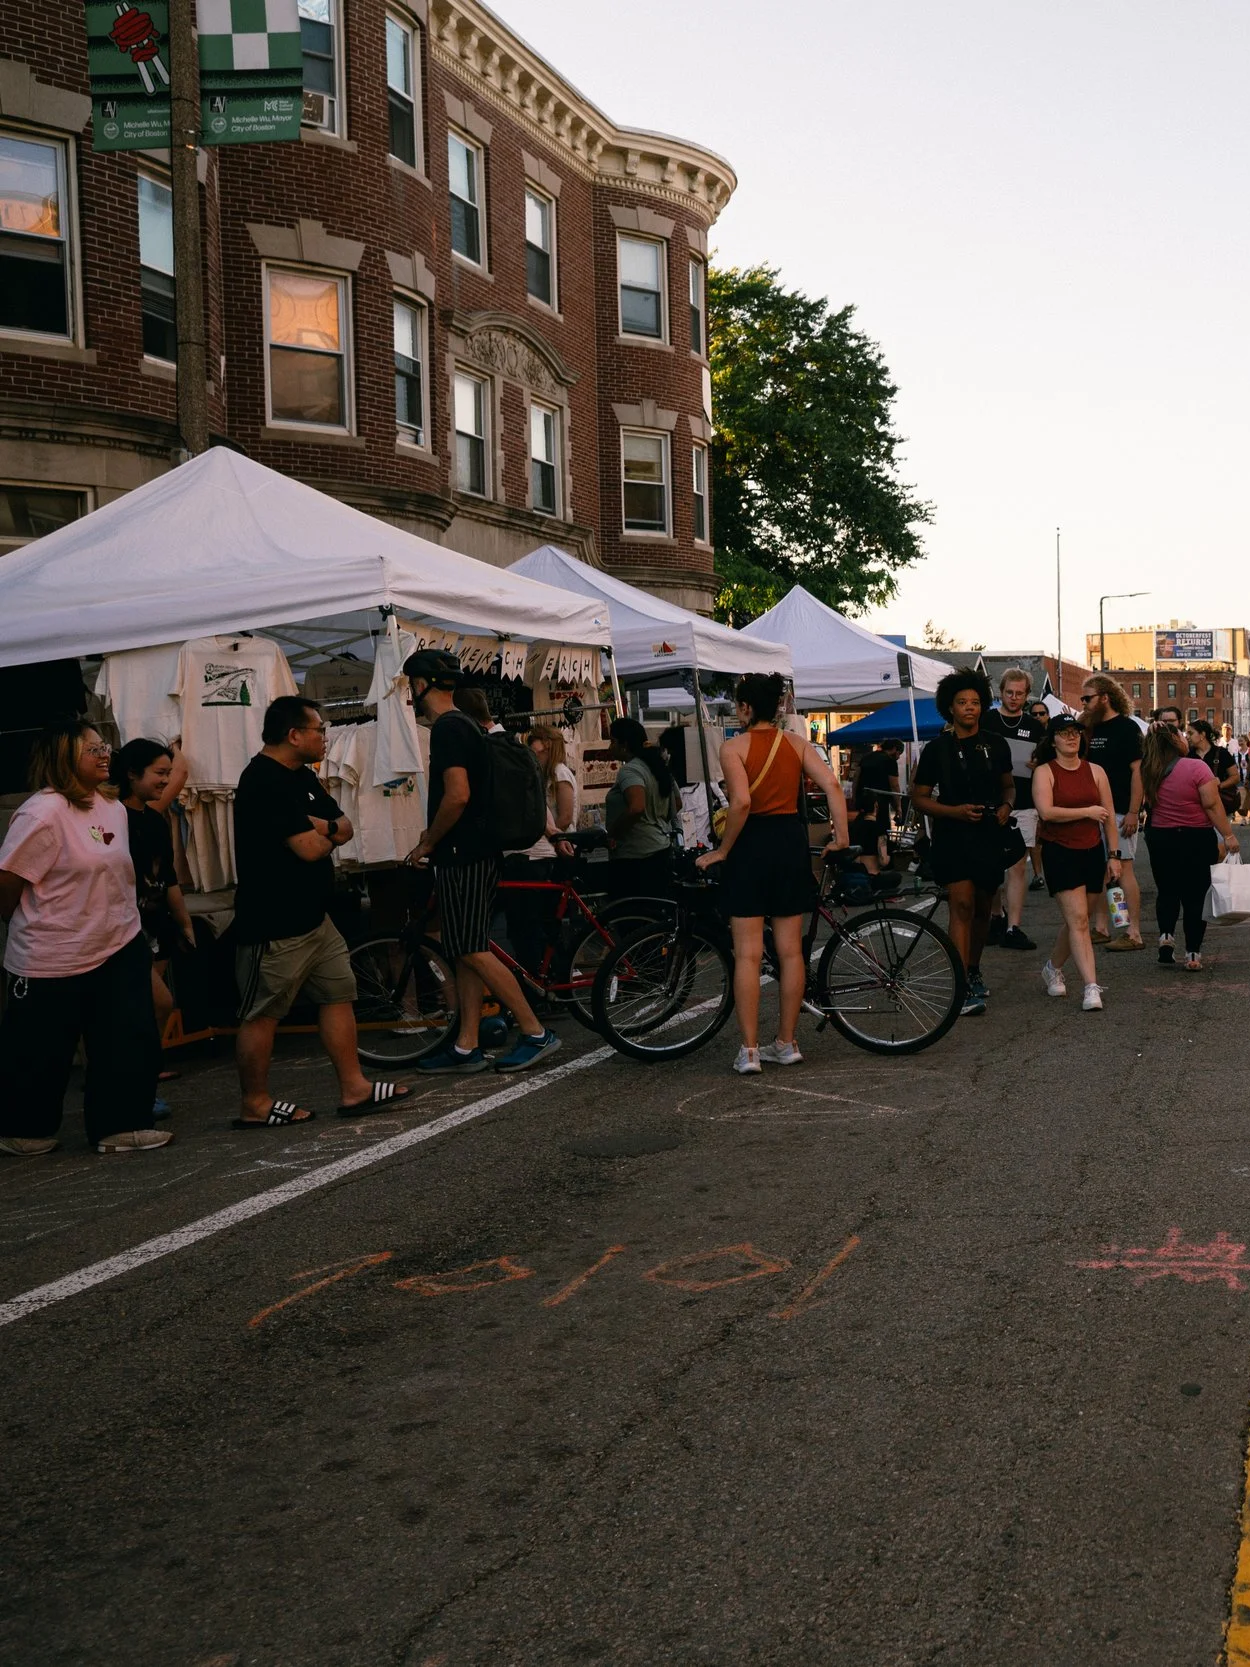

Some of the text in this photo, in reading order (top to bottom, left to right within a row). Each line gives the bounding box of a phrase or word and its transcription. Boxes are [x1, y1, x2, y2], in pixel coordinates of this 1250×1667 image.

[231, 116, 259, 124] Michelle
[272, 115, 293, 124] Mayor
[123, 121, 150, 129] Michelle
[231, 125, 244, 133] City
[1176, 638, 1212, 646] RETURNS
[458, 646, 524, 670] MERCH
